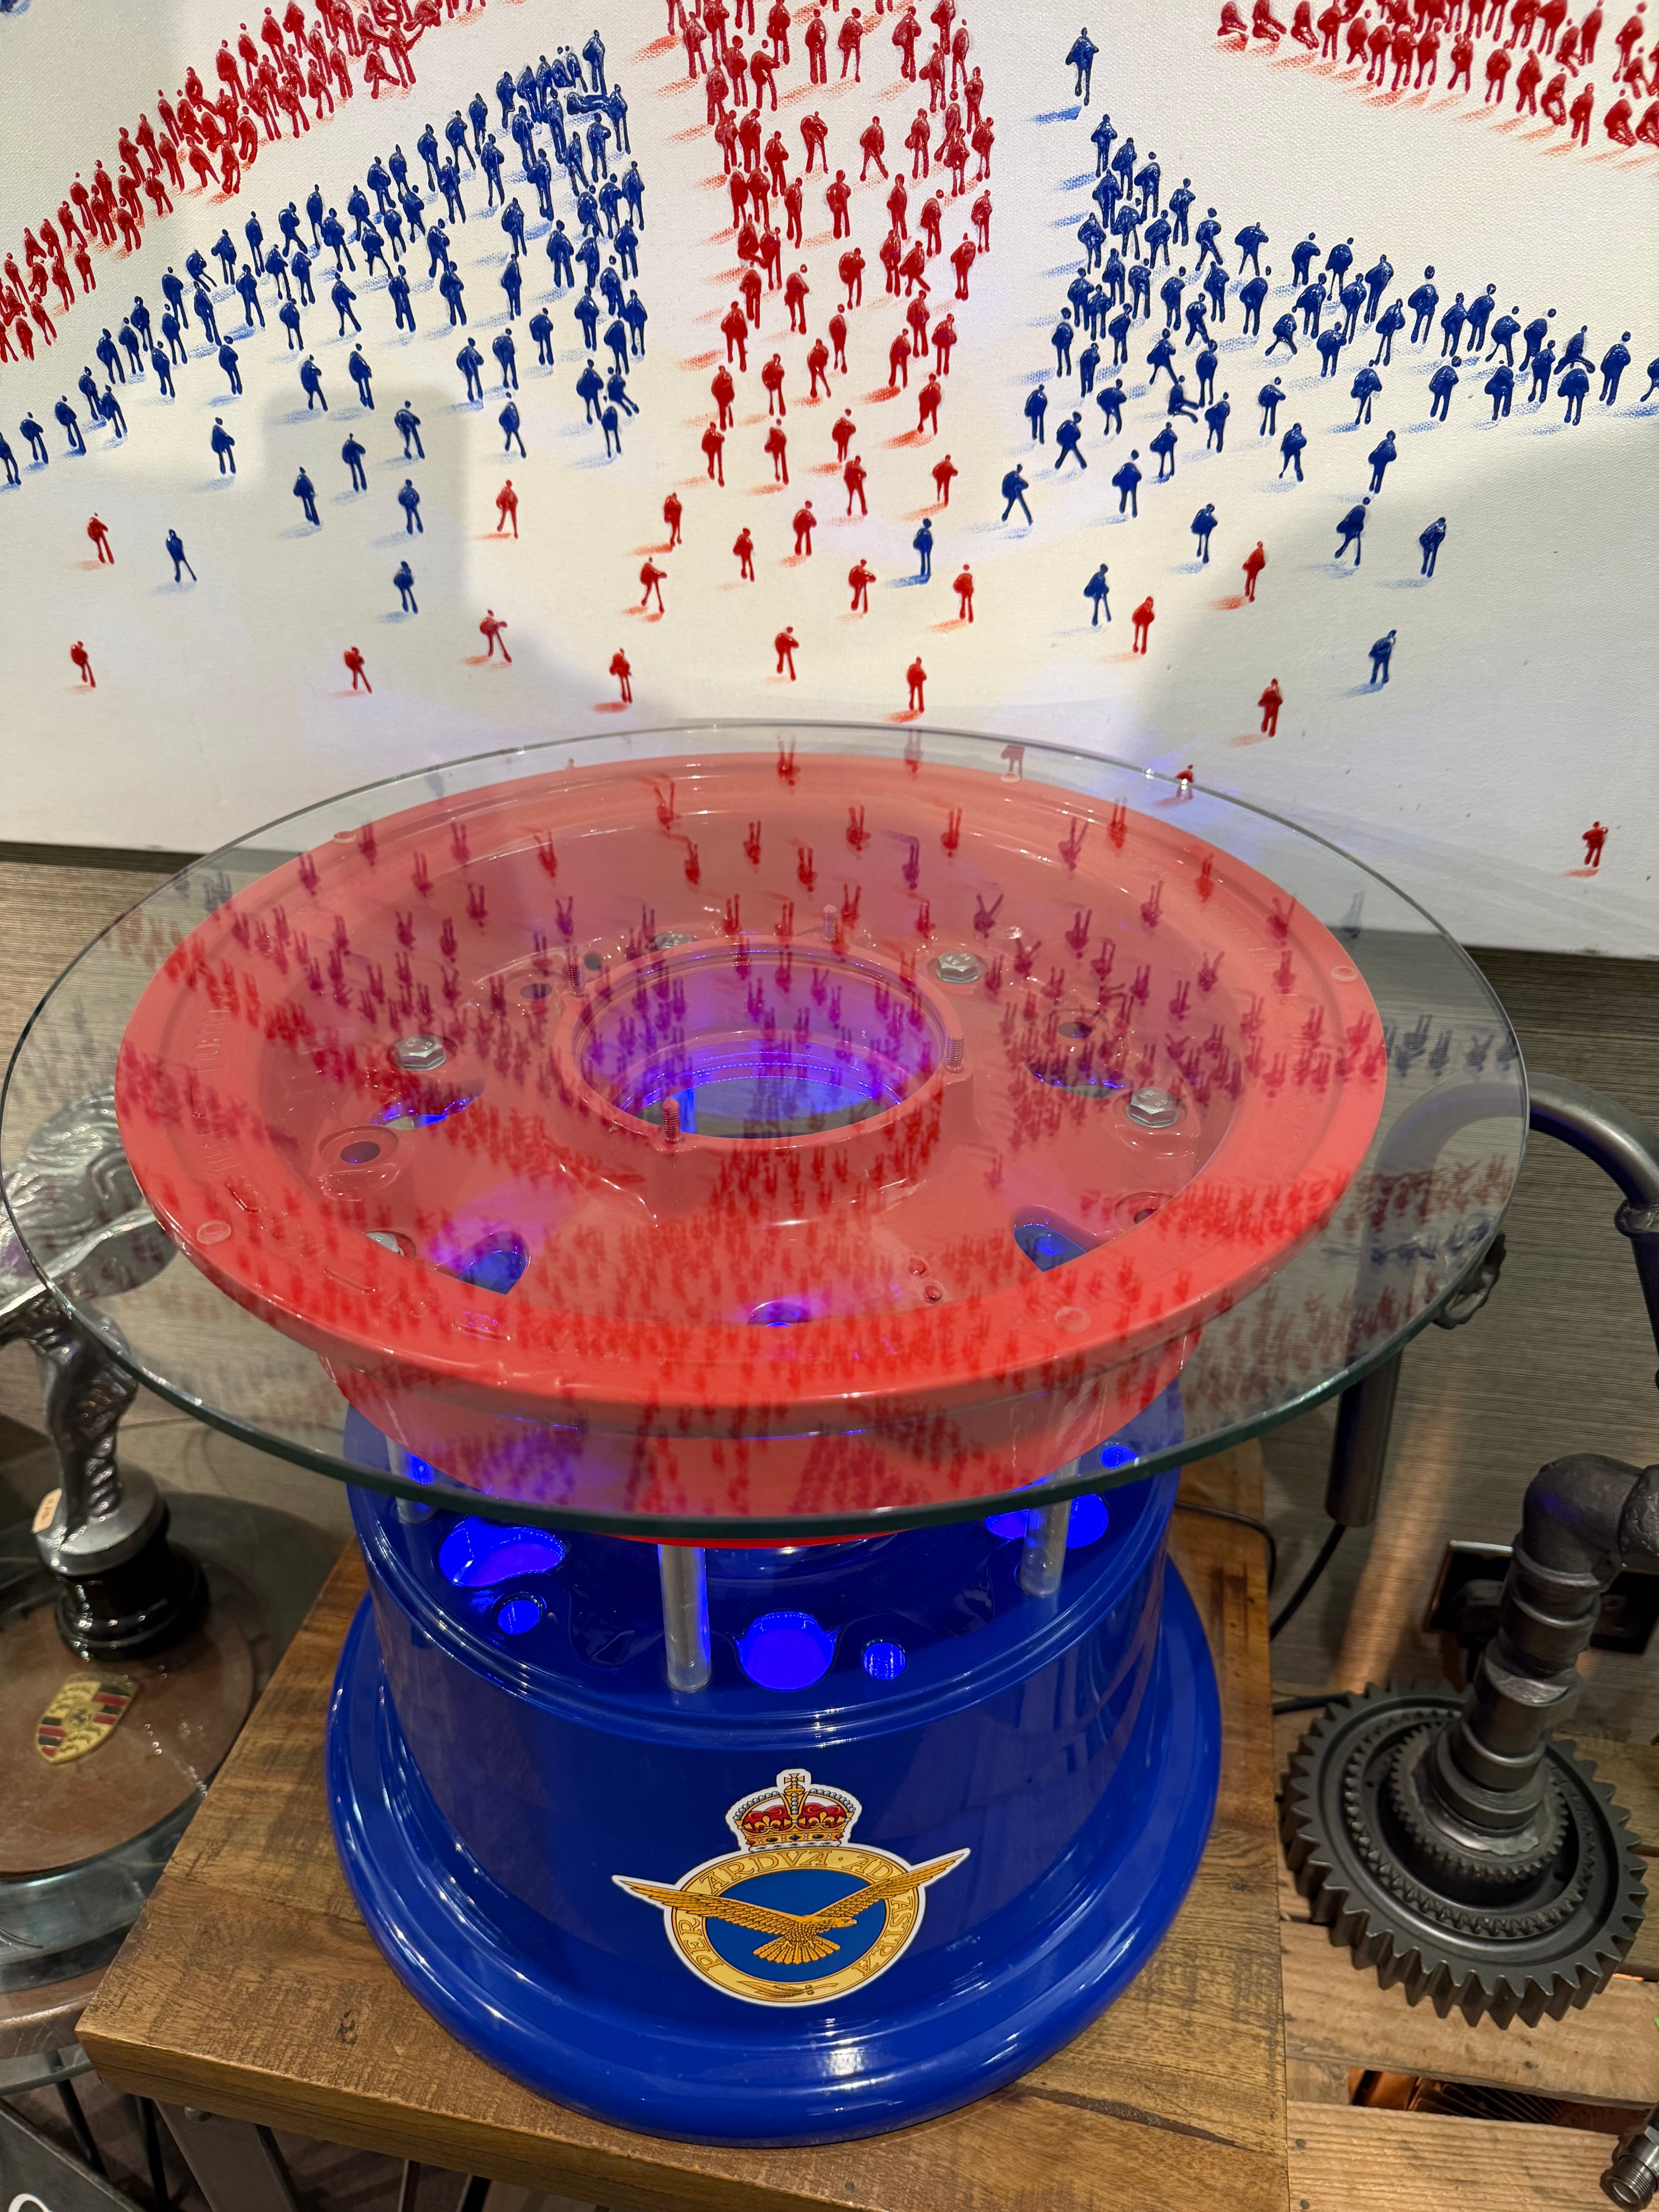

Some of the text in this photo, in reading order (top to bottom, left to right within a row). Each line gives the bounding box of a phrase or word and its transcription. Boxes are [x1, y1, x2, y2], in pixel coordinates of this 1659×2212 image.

[678, 1850, 913, 1976] PER ARDVA AD ASTRA
